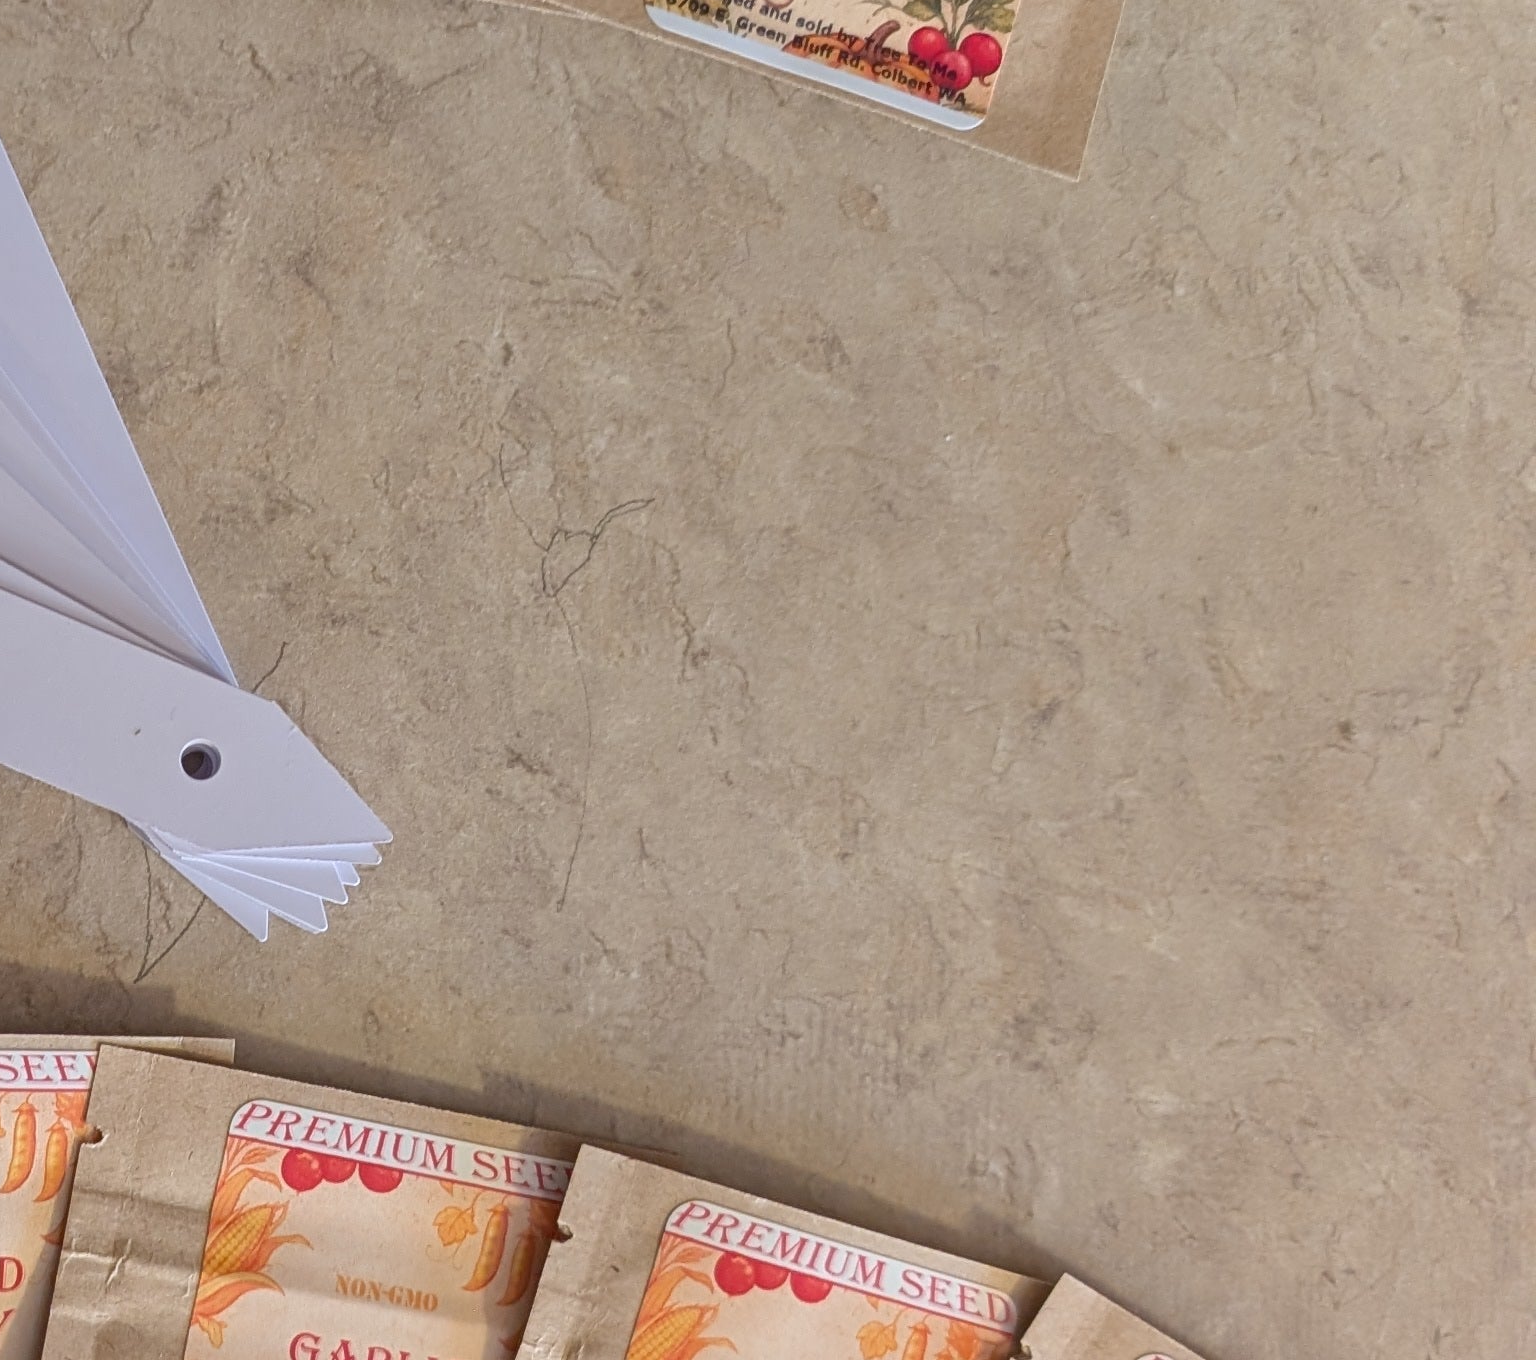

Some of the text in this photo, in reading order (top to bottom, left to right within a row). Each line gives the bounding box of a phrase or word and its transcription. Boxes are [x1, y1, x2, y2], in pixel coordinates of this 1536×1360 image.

[795, 16, 835, 39] sold
[832, 26, 861, 57] by
[334, 1273, 439, 1313] NON-GMO
